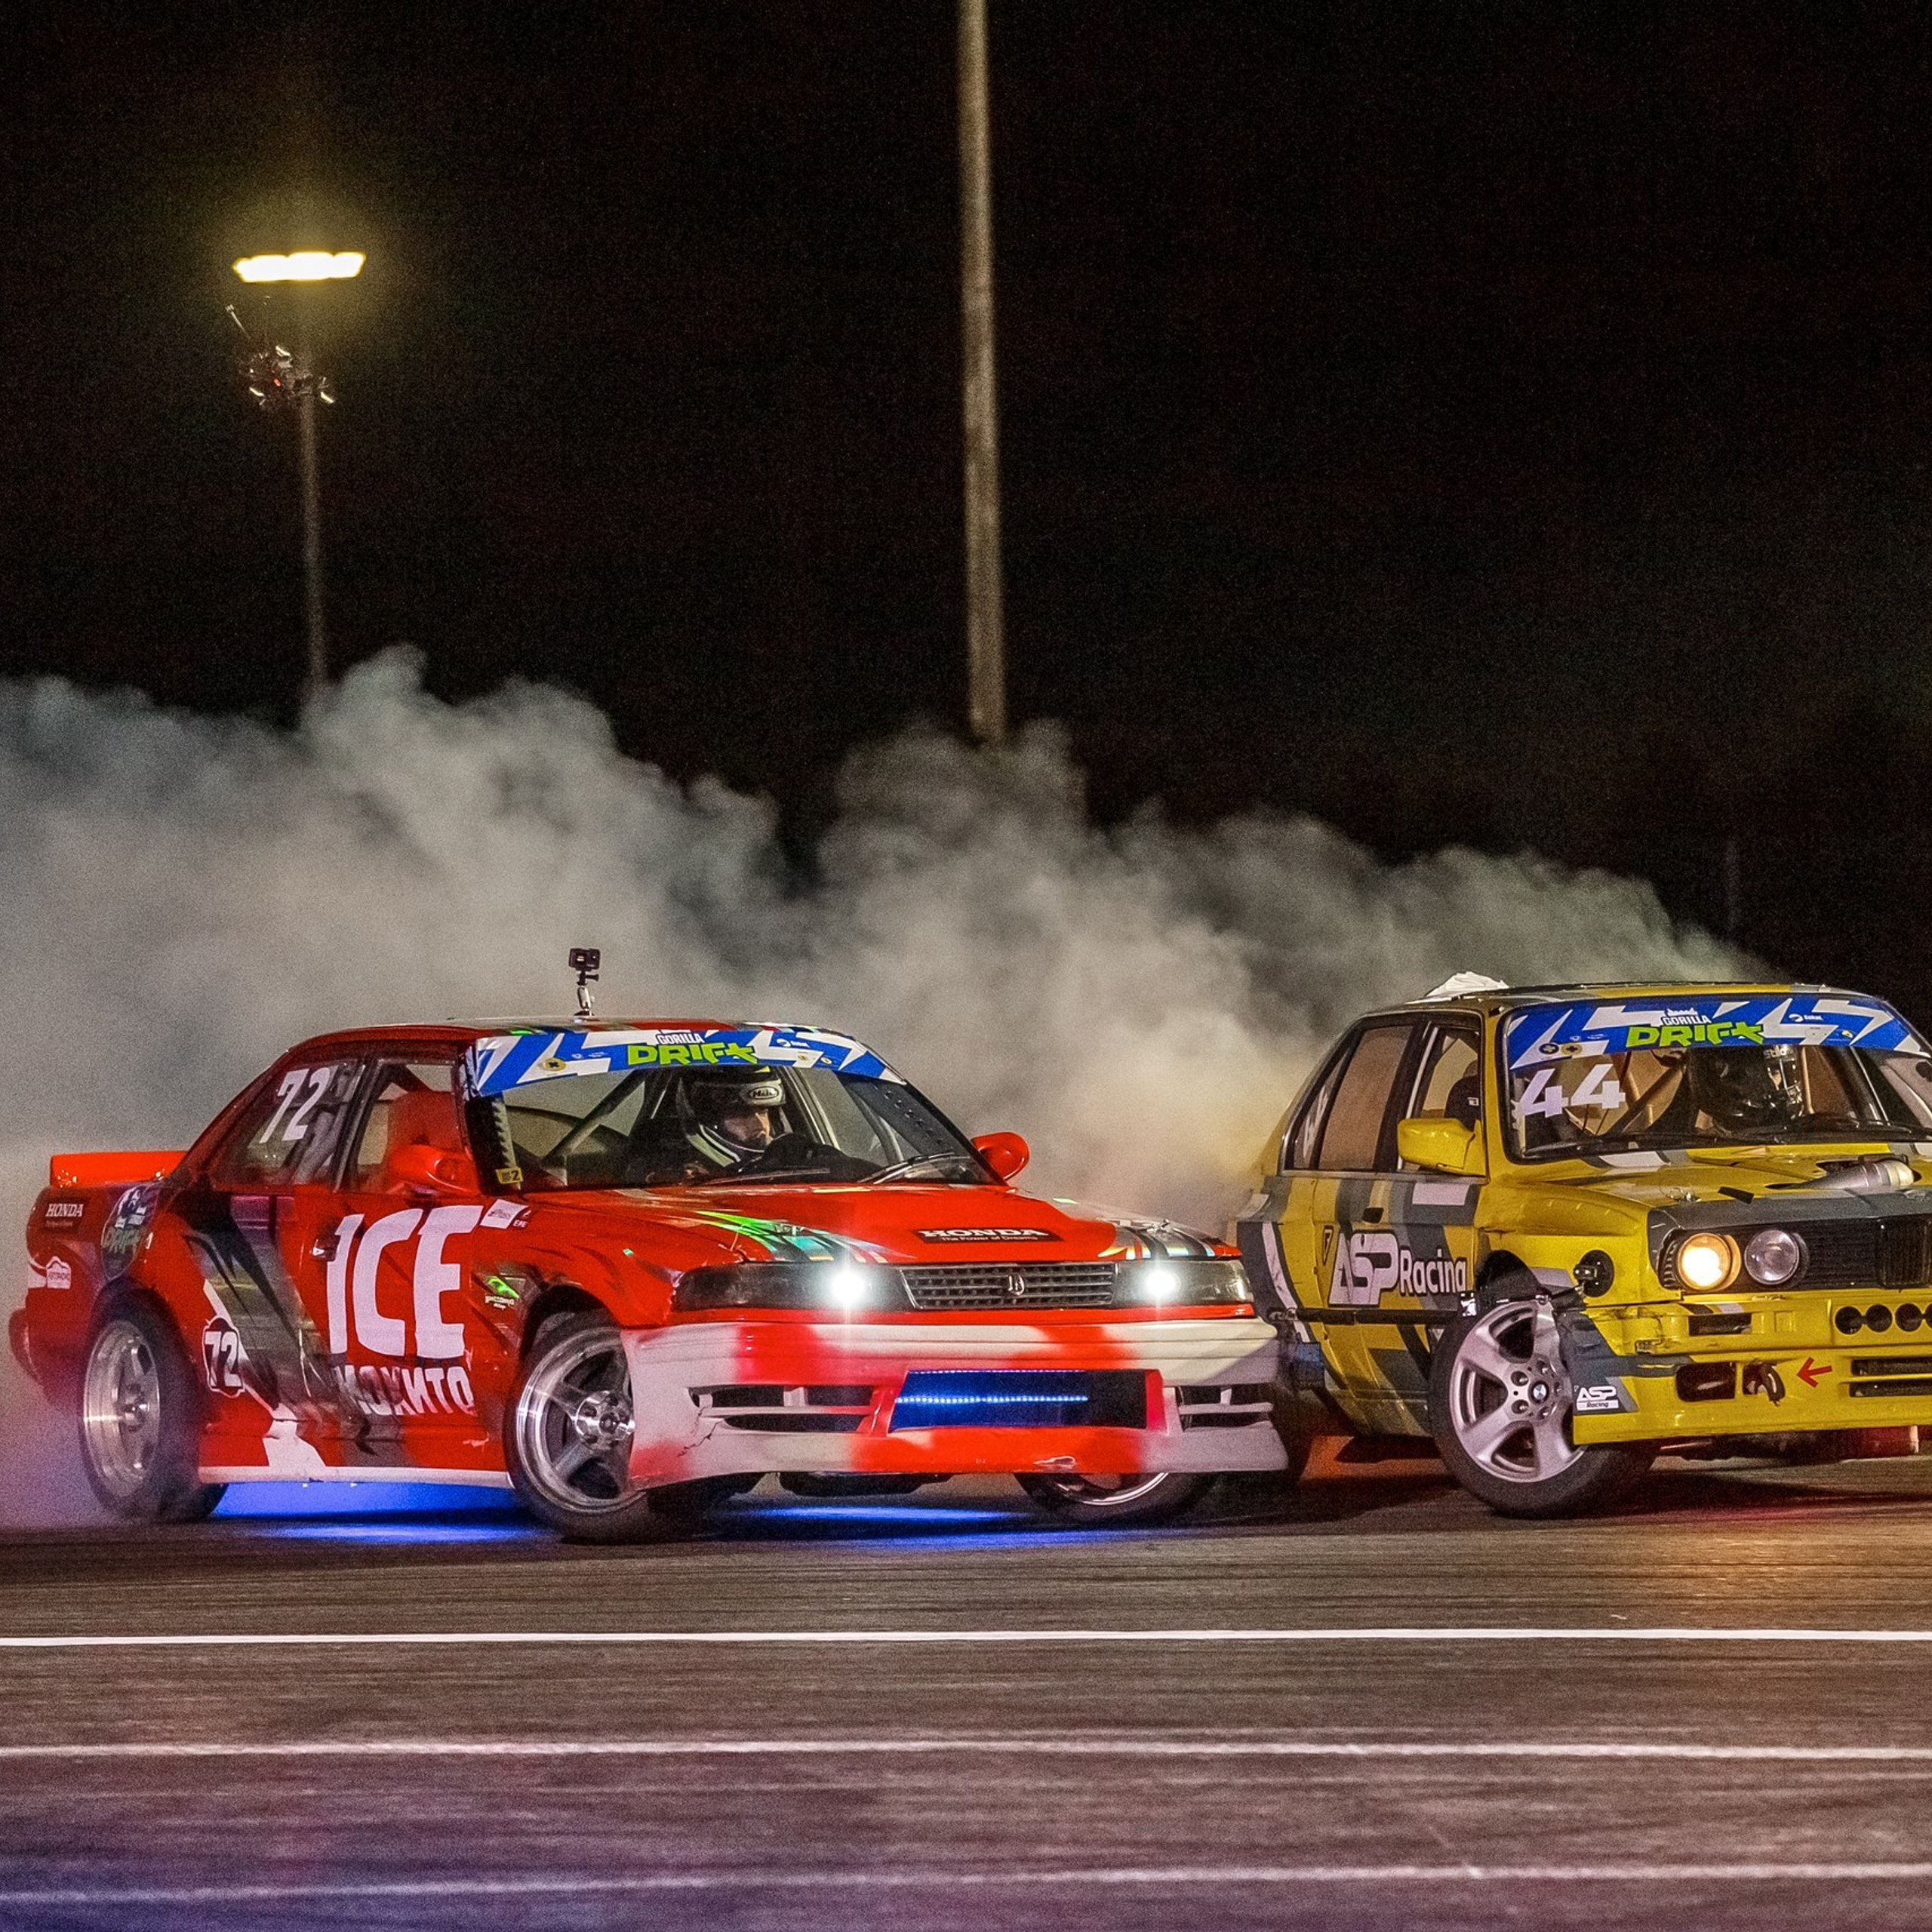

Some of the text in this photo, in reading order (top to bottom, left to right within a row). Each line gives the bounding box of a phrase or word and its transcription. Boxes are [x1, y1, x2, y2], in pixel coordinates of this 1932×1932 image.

[1663, 1015, 1712, 1026] GORILLA
[656, 1032, 705, 1044] GORILLA
[1626, 1022, 1764, 1048] DRIFT
[627, 1042, 758, 1066] DRIFT
[1519, 1063, 1626, 1118] 44
[259, 1067, 331, 1144] 72
[45, 1203, 84, 1217] HONDA
[918, 1229, 1049, 1237] HONDA
[1328, 1232, 1398, 1306] ASP
[327, 1205, 484, 1359] ICE
[205, 1331, 242, 1387] 72
[1577, 1386, 1617, 1401] ASP
